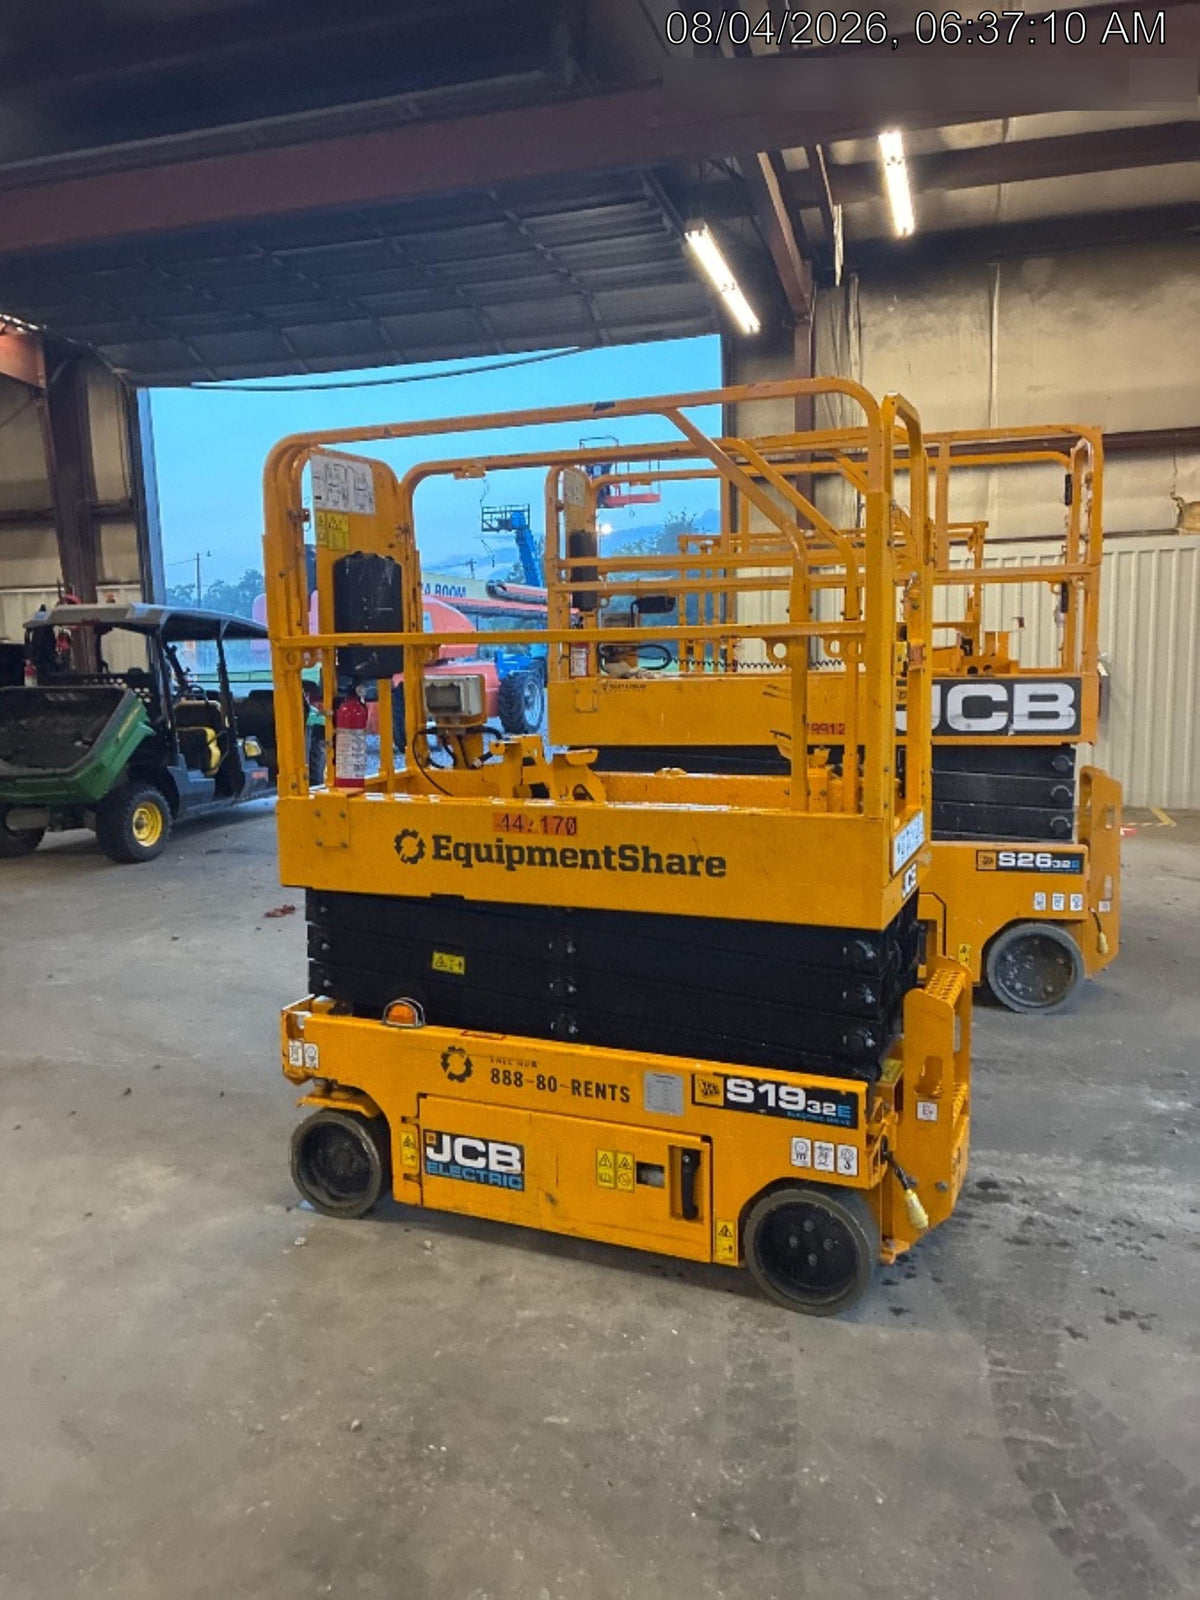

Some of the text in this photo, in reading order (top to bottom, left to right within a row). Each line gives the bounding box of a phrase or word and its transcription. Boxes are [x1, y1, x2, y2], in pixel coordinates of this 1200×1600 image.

[435, 584, 467, 598] BOOM
[432, 833, 727, 878] EquipmentShare
[425, 1133, 522, 1174] JCB
[426, 1161, 523, 1189] ELECTRIC
